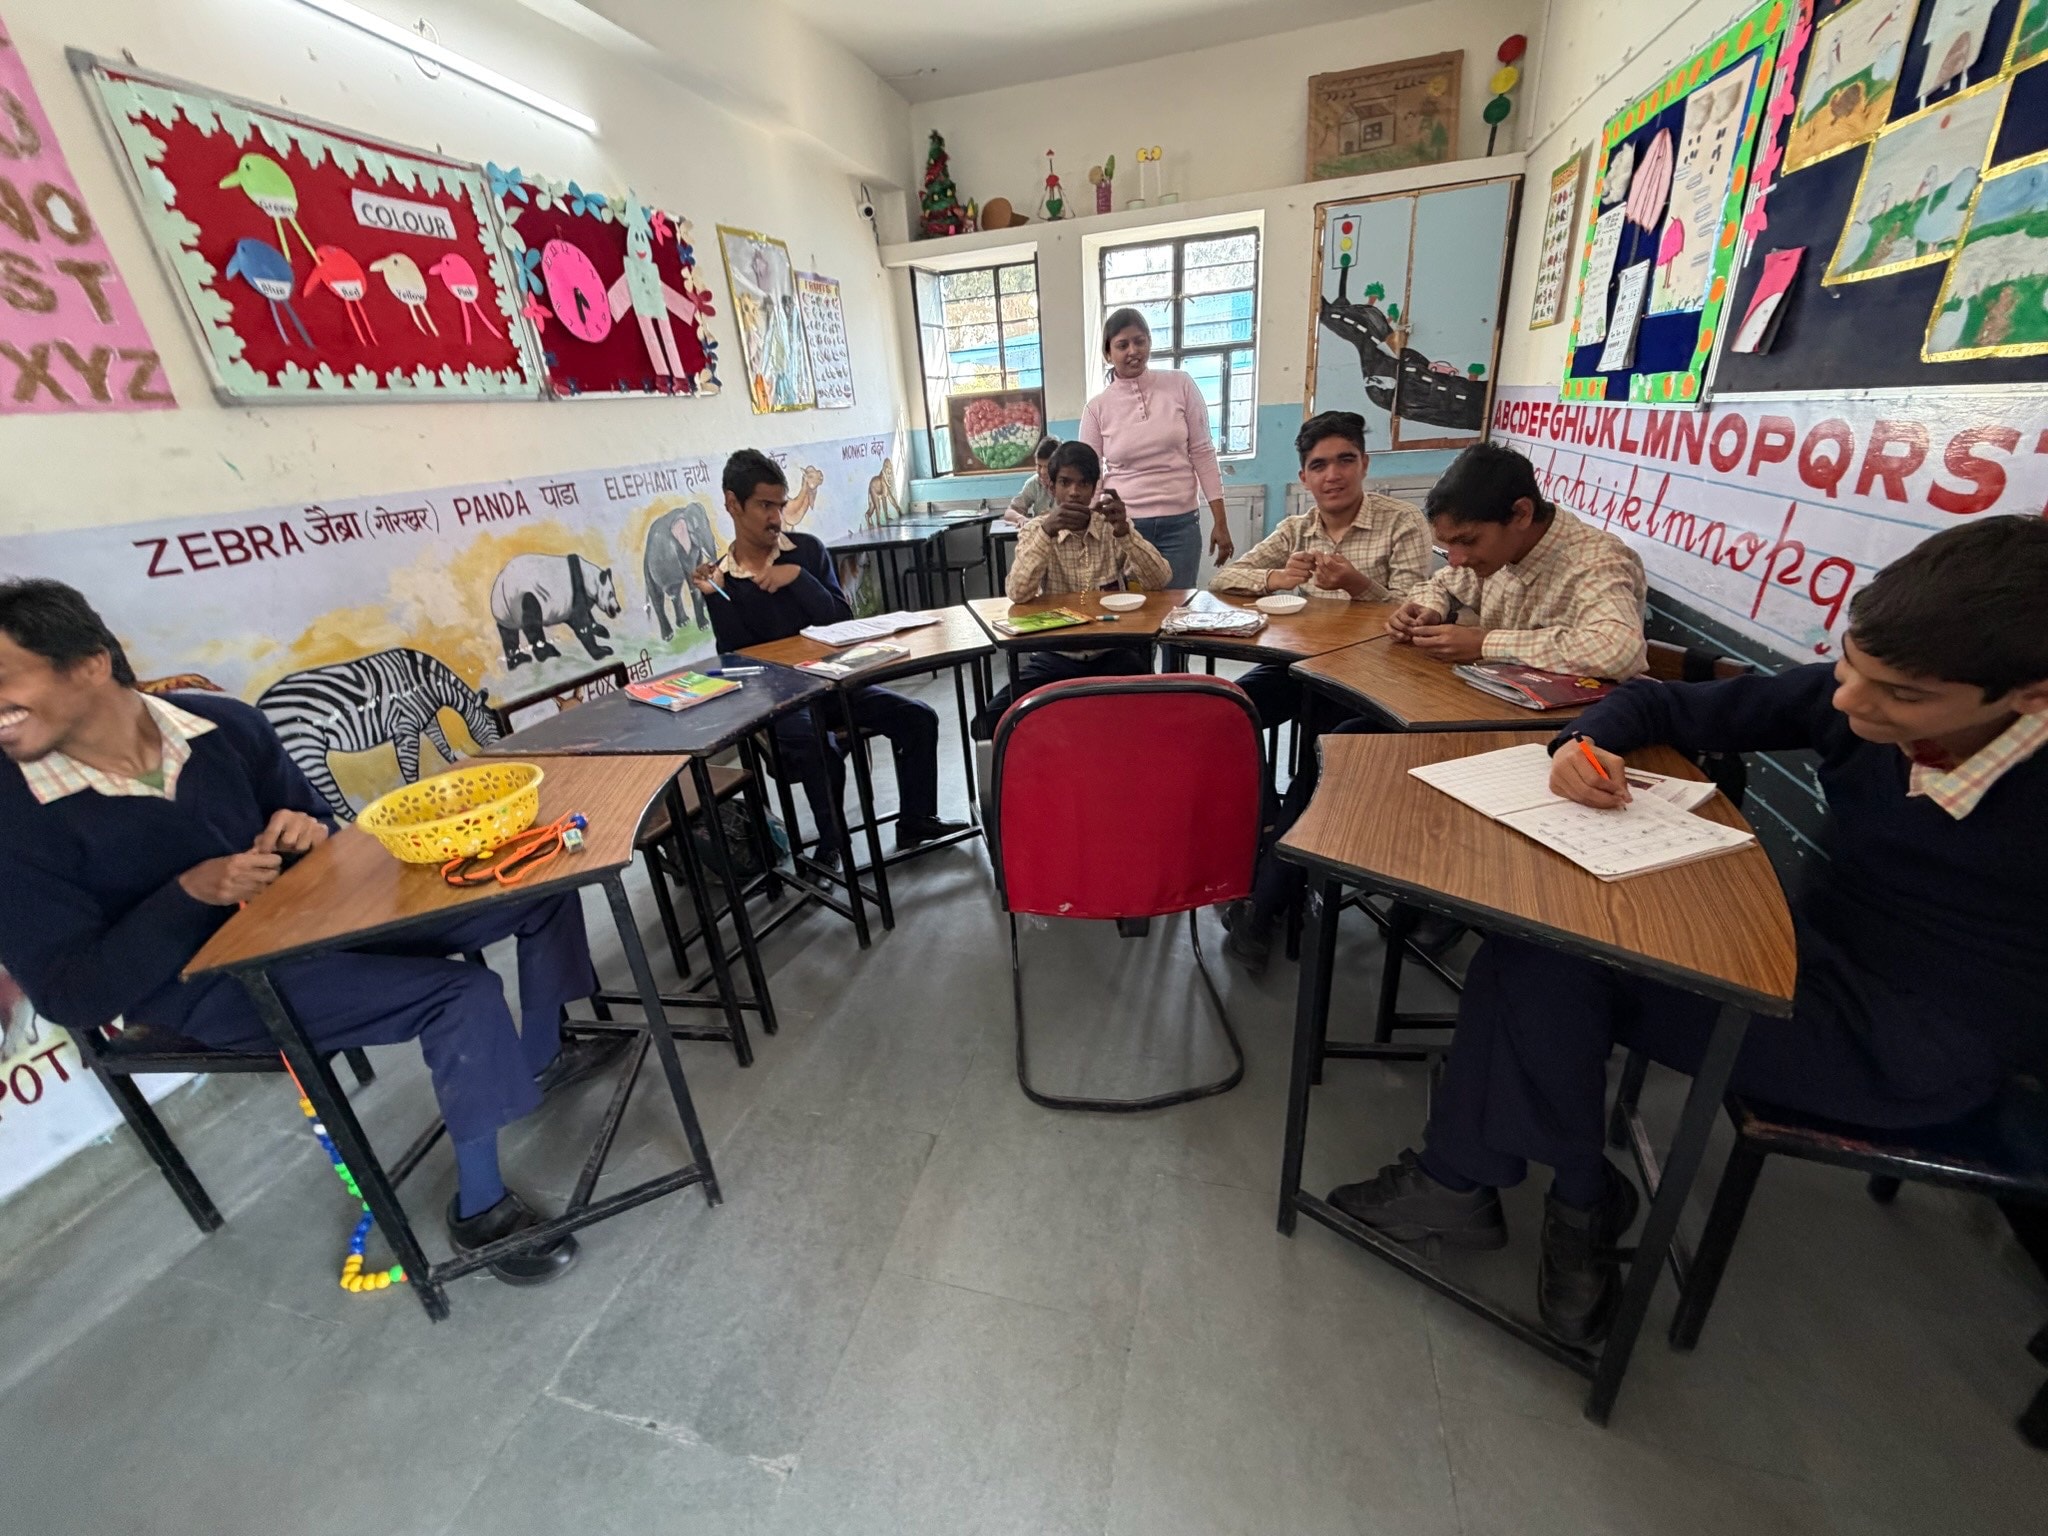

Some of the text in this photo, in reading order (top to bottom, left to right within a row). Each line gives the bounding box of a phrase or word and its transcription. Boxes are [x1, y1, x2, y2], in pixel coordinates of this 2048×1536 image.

[259, 201, 295, 213] Green
[361, 202, 449, 239] COLOUR
[261, 282, 286, 295] Blue
[341, 286, 360, 297] Red
[396, 288, 425, 300] Yellow
[456, 286, 474, 297] Pink
[841, 442, 867, 461] MONKEY
[603, 460, 711, 501] ELEPHANT हाथी
[452, 480, 580, 526] PANDA पांडा
[132, 520, 304, 578] ZEBRA
[587, 675, 616, 701] FOX
